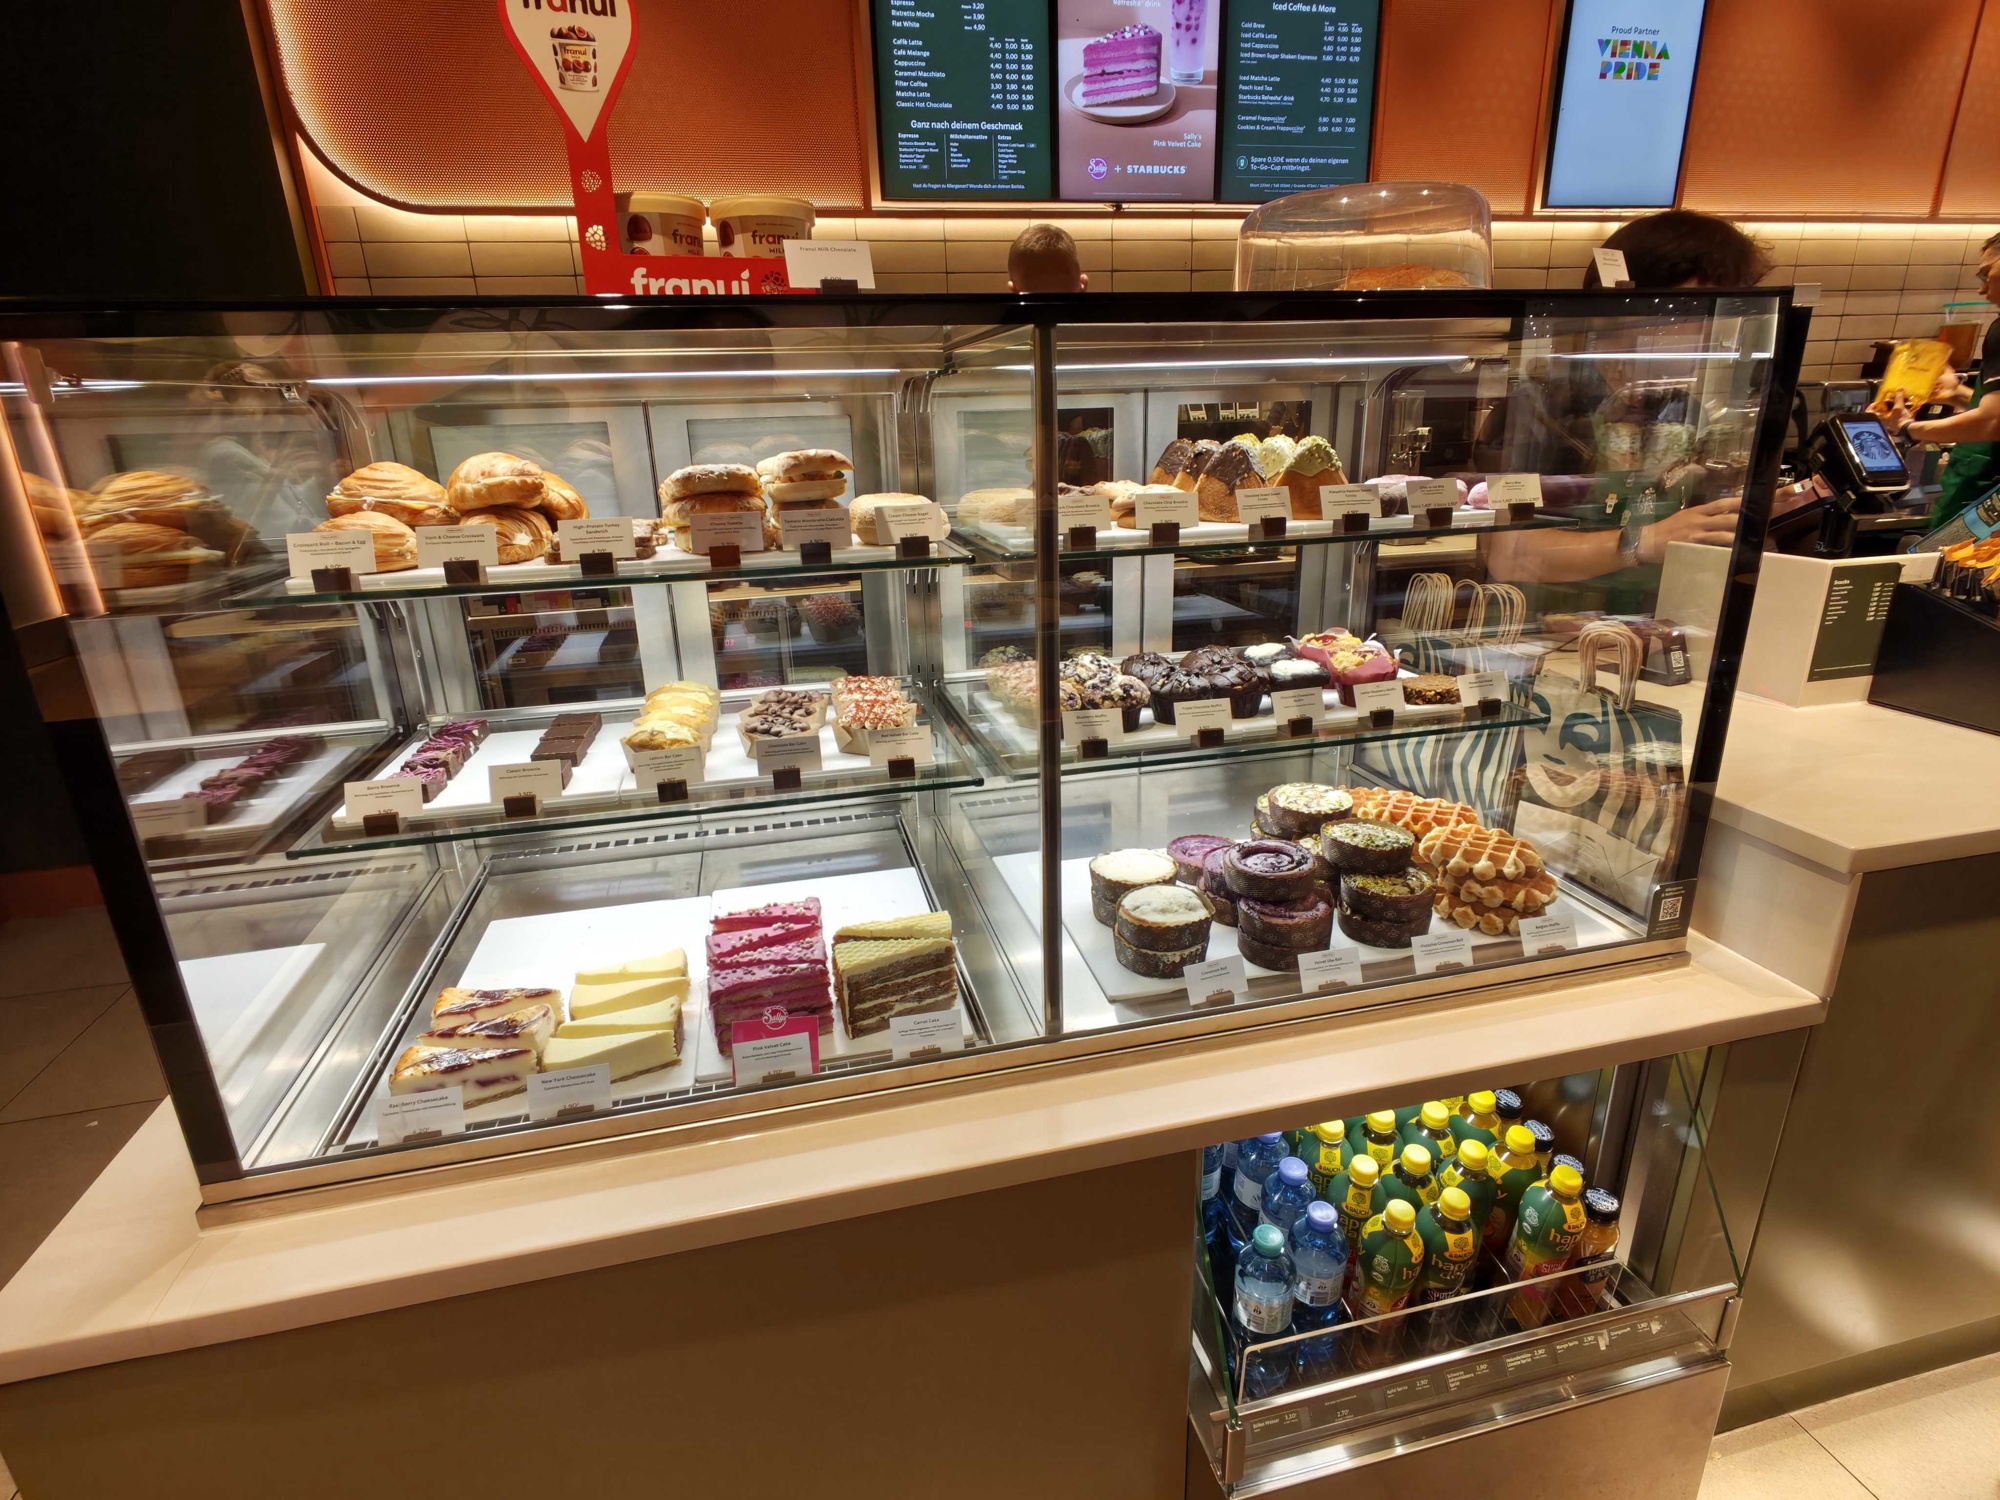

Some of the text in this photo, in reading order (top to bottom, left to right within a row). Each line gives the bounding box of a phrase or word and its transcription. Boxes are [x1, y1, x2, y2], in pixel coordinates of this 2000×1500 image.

[1272, 2, 1336, 13] Iced Coffee & More
[1611, 26, 1660, 35] Proud Partner
[1251, 42, 1279, 50] Cappuccino
[1597, 39, 1670, 59] VIENNA
[1599, 61, 1660, 80] PRIDE
[911, 120, 1023, 131] Ganz nach deinem Geschmack
[1250, 156, 1266, 164] Spare
[1127, 165, 1186, 174] STARBUCKS
[1250, 164, 1311, 172] To-Go-Cup mitbringst.
[565, 1072, 596, 1082] Cheesecake
[417, 1095, 449, 1105] Cheesecake
[1349, 1207, 1370, 1215] RAUCH
